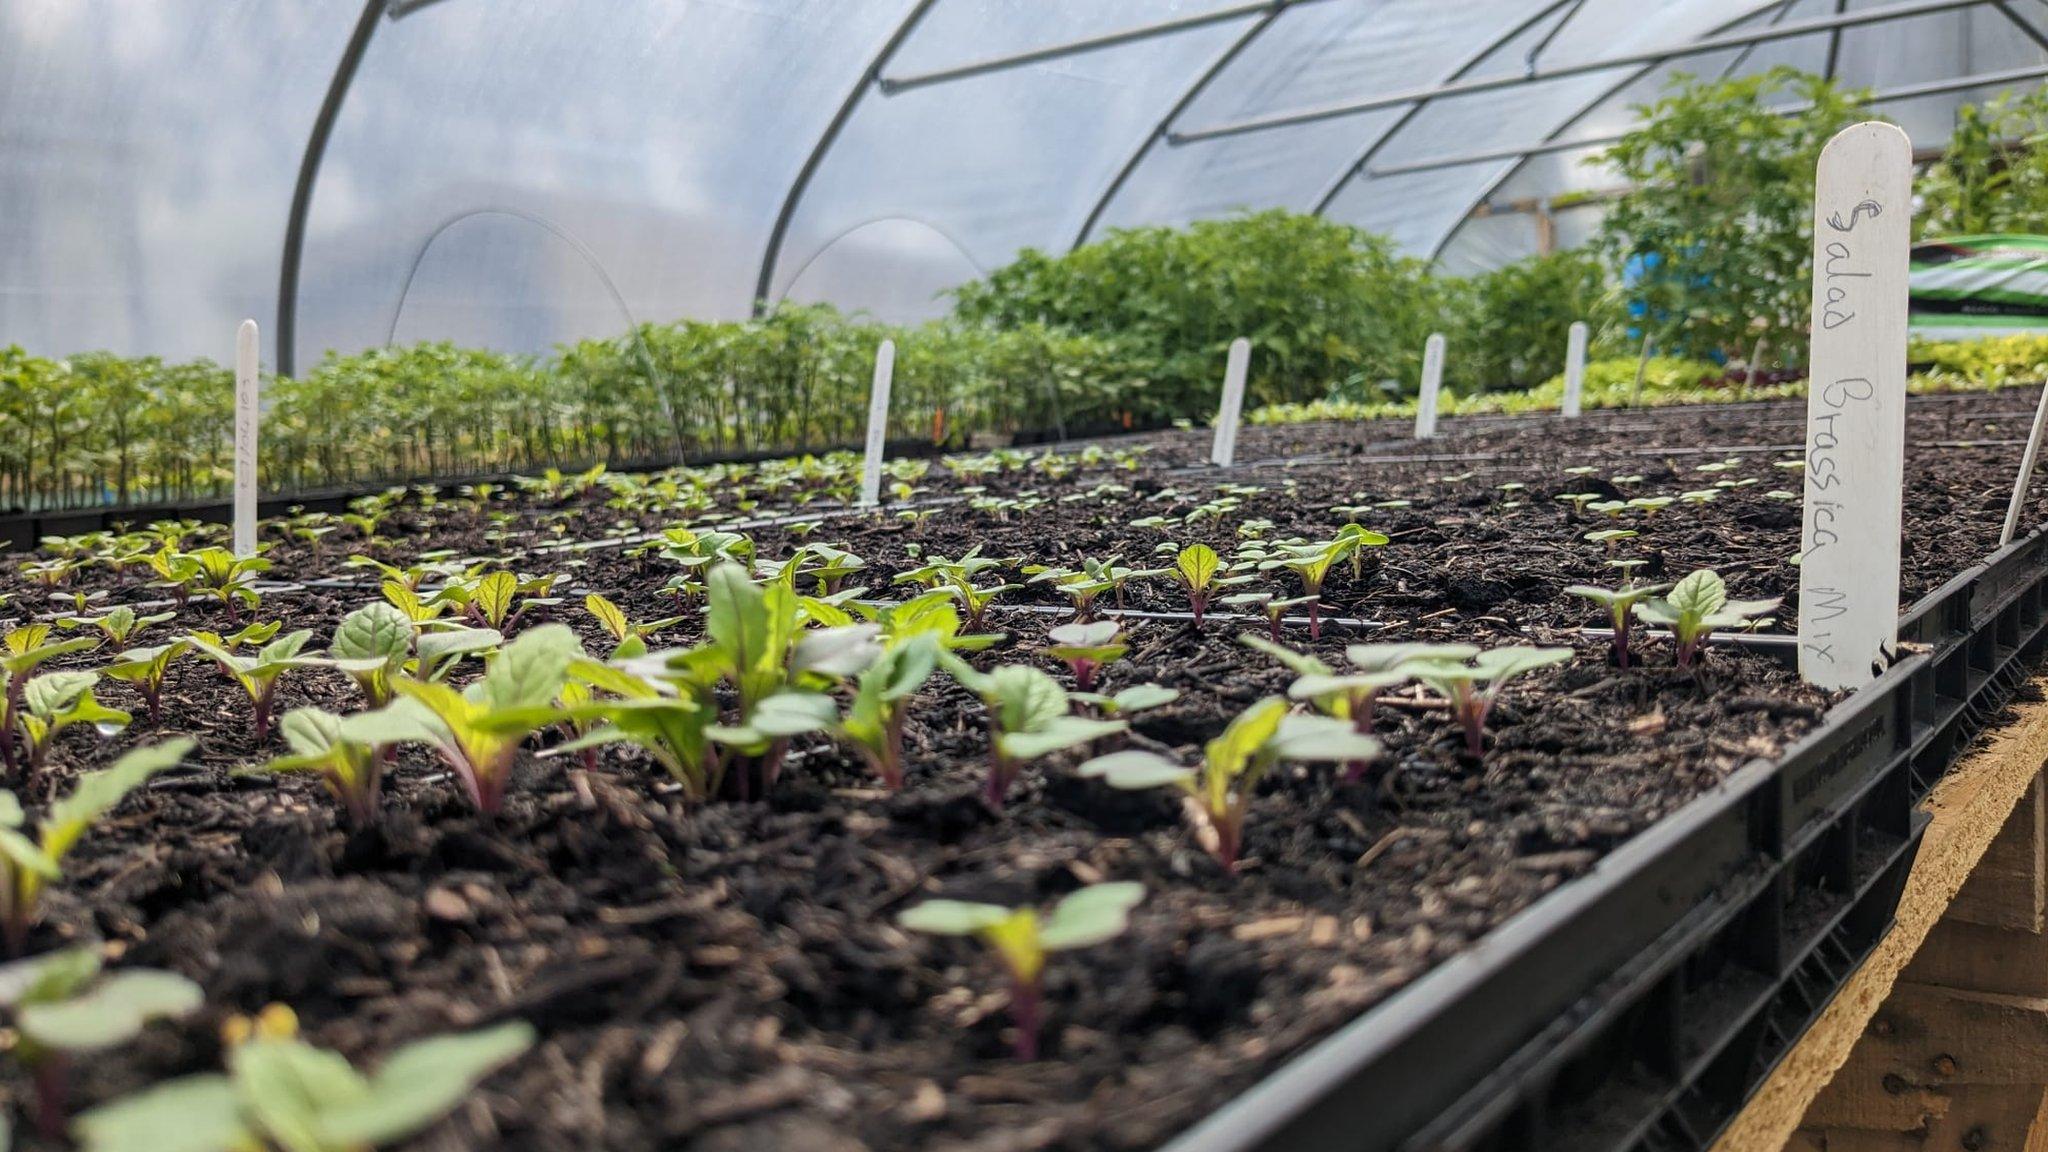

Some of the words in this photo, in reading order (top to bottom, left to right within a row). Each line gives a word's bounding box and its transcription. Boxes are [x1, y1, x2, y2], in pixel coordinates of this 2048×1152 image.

[1823, 199, 1882, 329] Salad
[1801, 377, 1873, 559] Brassica
[1803, 587, 1848, 663] Mix
